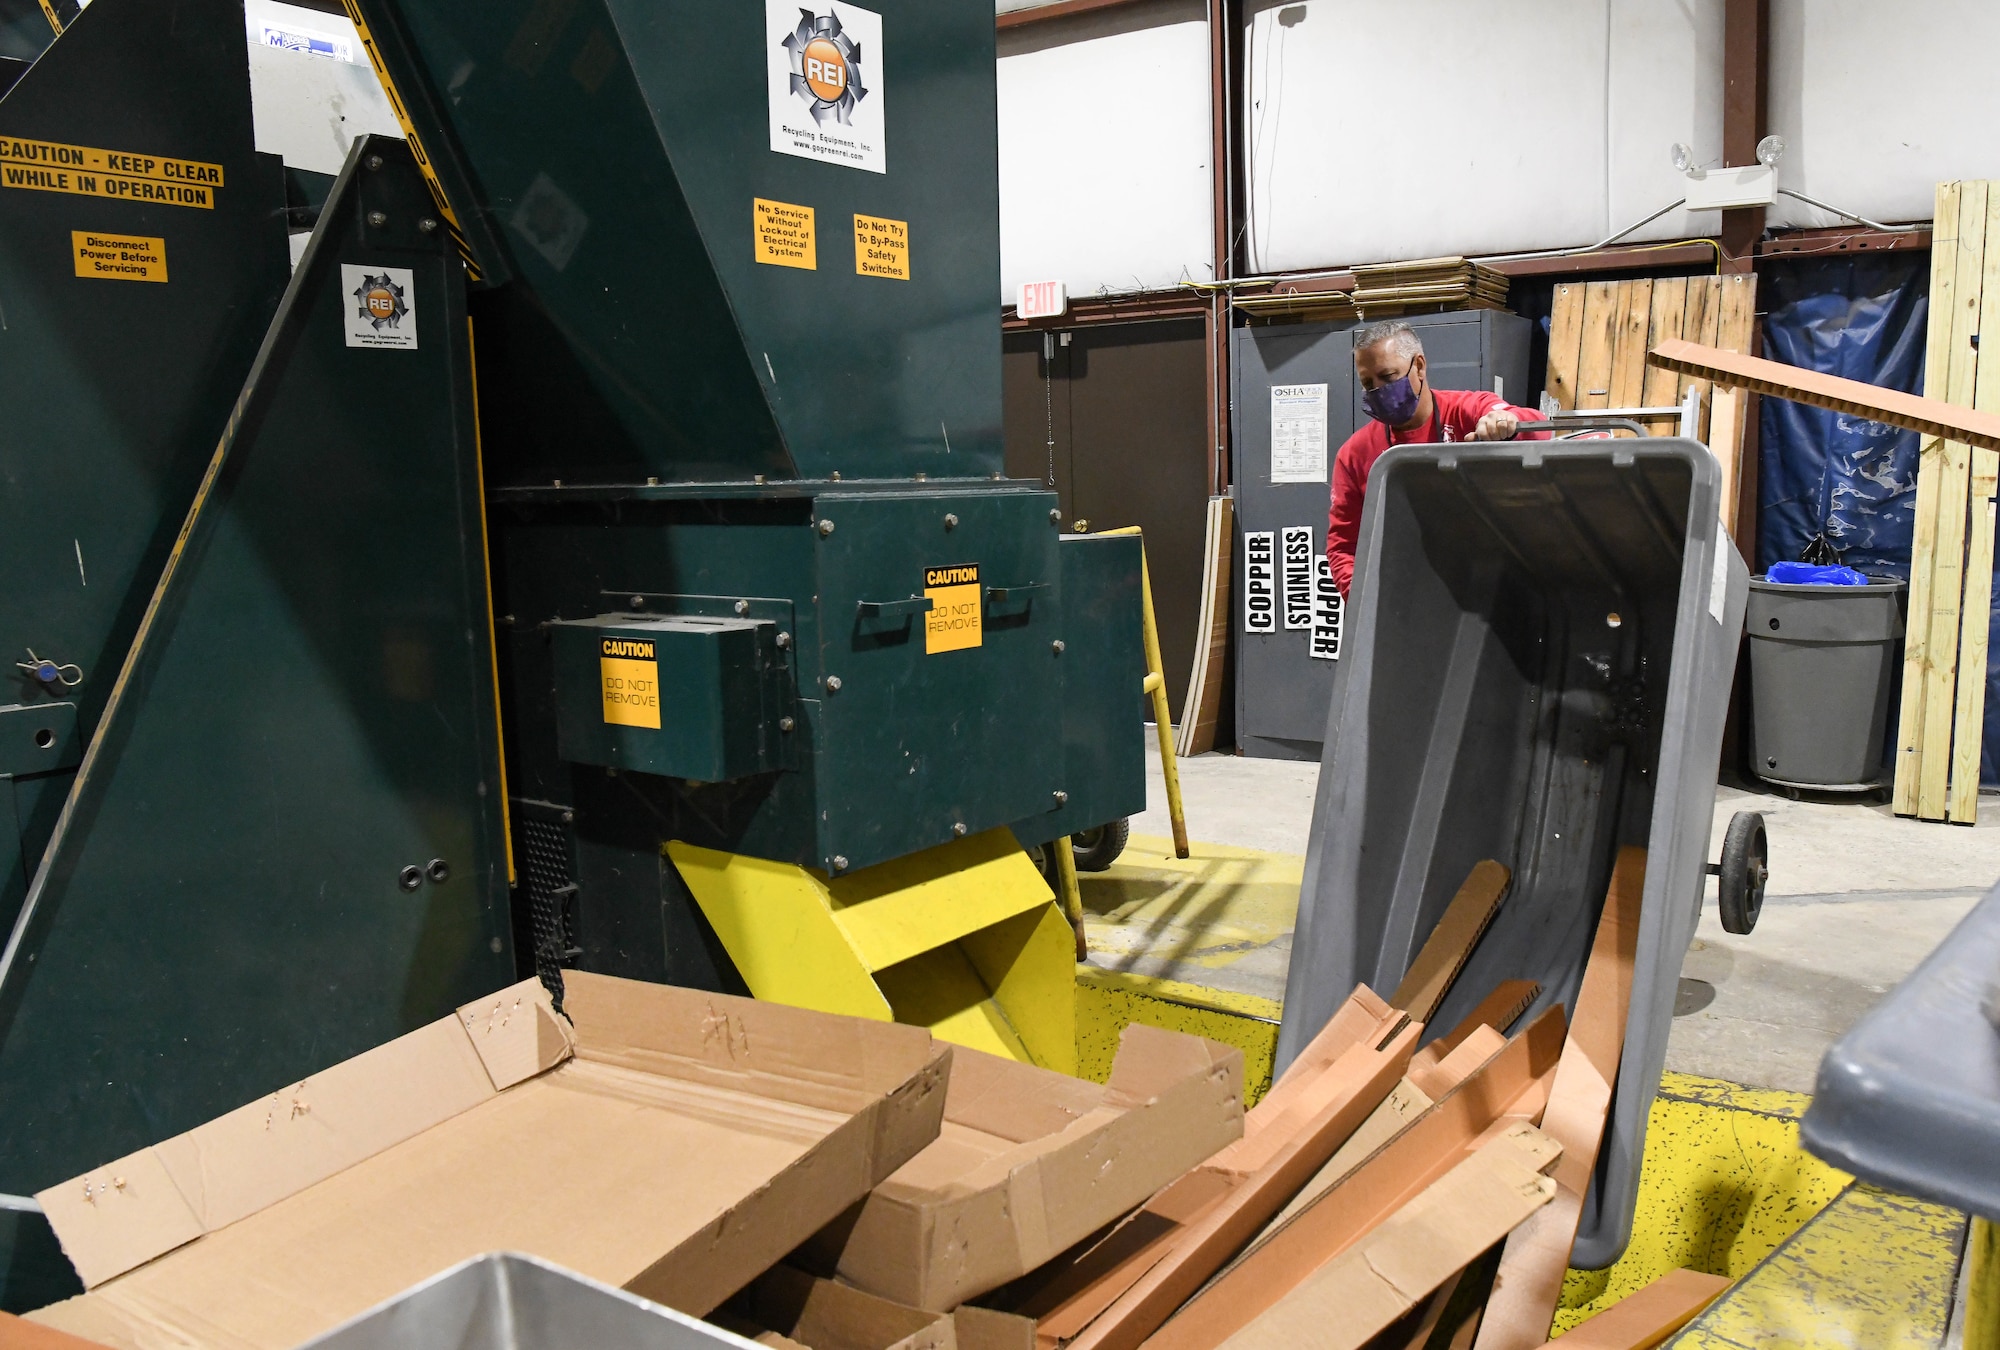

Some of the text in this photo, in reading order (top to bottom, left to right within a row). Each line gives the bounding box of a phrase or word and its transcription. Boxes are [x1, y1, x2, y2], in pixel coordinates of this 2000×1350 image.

[807, 57, 844, 88] REI
[782, 125, 873, 152] Recycling Equipment, Inc.
[793, 140, 864, 161] www.gogreenrei.com
[0, 140, 83, 165] CAUTION
[108, 154, 155, 174] KEEP
[164, 162, 220, 183] CLEAR
[6, 168, 207, 205] WHILE IN OPERATION
[758, 204, 809, 220] No Service
[767, 215, 802, 229] Without
[856, 219, 904, 237] Do Not Try
[760, 225, 809, 239] Lockout of
[87, 237, 150, 251] Disconnect
[763, 235, 807, 249] Electrical
[857, 233, 905, 249] To By-Pass
[80, 249, 158, 263] Power Before
[768, 246, 803, 258] System
[867, 248, 896, 263] Safety
[94, 261, 147, 276] Servicing
[862, 262, 903, 276] Switches
[369, 298, 393, 310] REI
[1023, 281, 1056, 315] EXIT
[1274, 388, 1304, 396] OSHA
[927, 567, 978, 585] CAUTION
[1248, 537, 1271, 628] COPPER
[1285, 531, 1311, 625] STAINLESS
[930, 603, 976, 618] DO NOT
[928, 616, 979, 632] REMOVE
[602, 640, 654, 658] CAUTION
[606, 677, 653, 692] DO NOT
[605, 692, 656, 707] REMOVE
